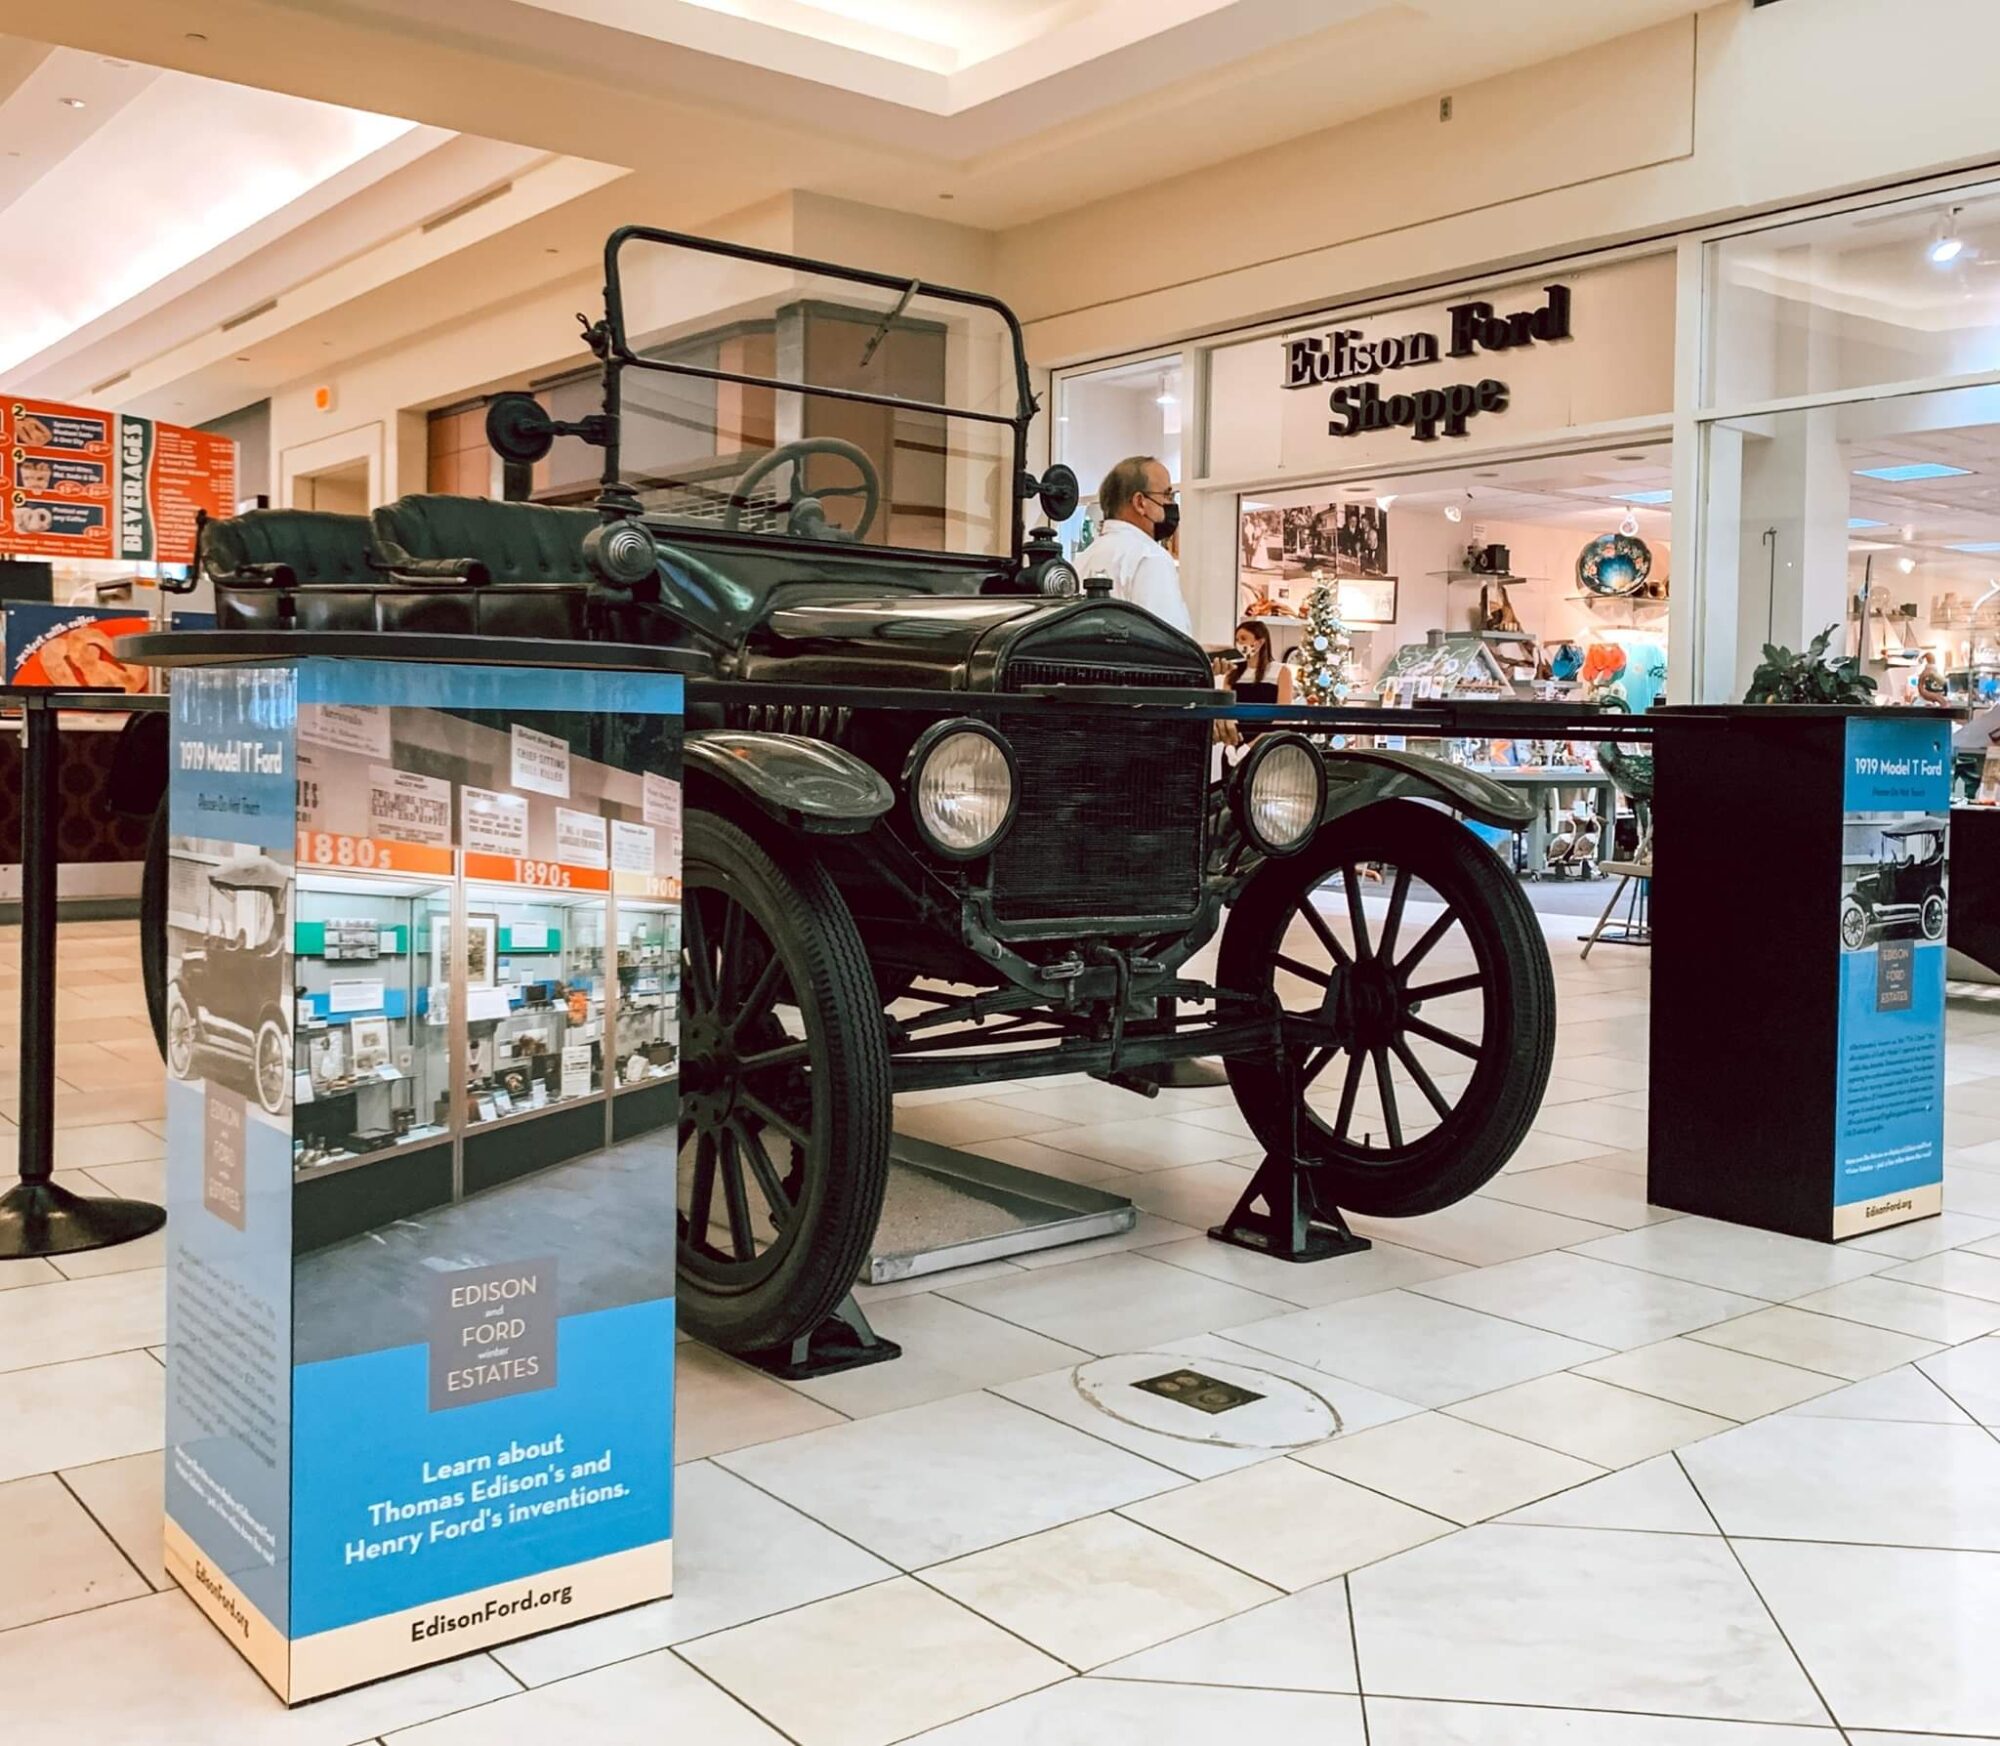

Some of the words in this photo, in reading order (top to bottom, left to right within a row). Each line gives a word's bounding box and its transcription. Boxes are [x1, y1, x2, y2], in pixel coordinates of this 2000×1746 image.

[1281, 329, 1442, 389] Edison
[1445, 284, 1573, 358] Ford
[14, 406, 23, 417] 2
[1328, 379, 1511, 441] Shoppe
[14, 450, 22, 460] 4
[14, 493, 23, 503] 6
[123, 423, 144, 553] BEVERAGES
[180, 740, 206, 771] 1919
[207, 739, 241, 773] Model
[242, 741, 253, 773] T
[254, 740, 283, 774] Ford
[1855, 757, 1879, 776] 1919
[1880, 758, 1911, 776] Model
[1912, 759, 1919, 776] T
[1920, 759, 1943, 777] Ford
[299, 831, 393, 869] 1880s
[512, 859, 571, 888] 1890s
[1865, 1199, 1913, 1218] EdisonFord.org
[451, 1275, 537, 1308] EDISON
[485, 1305, 505, 1318] and
[462, 1318, 526, 1347] FORD
[477, 1347, 510, 1360] winter
[447, 1356, 540, 1392] ESTATES
[422, 1453, 492, 1485] Learn
[497, 1433, 565, 1466] about
[368, 1491, 465, 1527] Thomas
[471, 1464, 566, 1503] Edison's
[570, 1449, 612, 1480] and
[344, 1532, 423, 1566] Henry
[429, 1508, 503, 1544] Ford's
[508, 1481, 631, 1525] inventions.
[411, 1585, 573, 1643] EdisonFord.org
